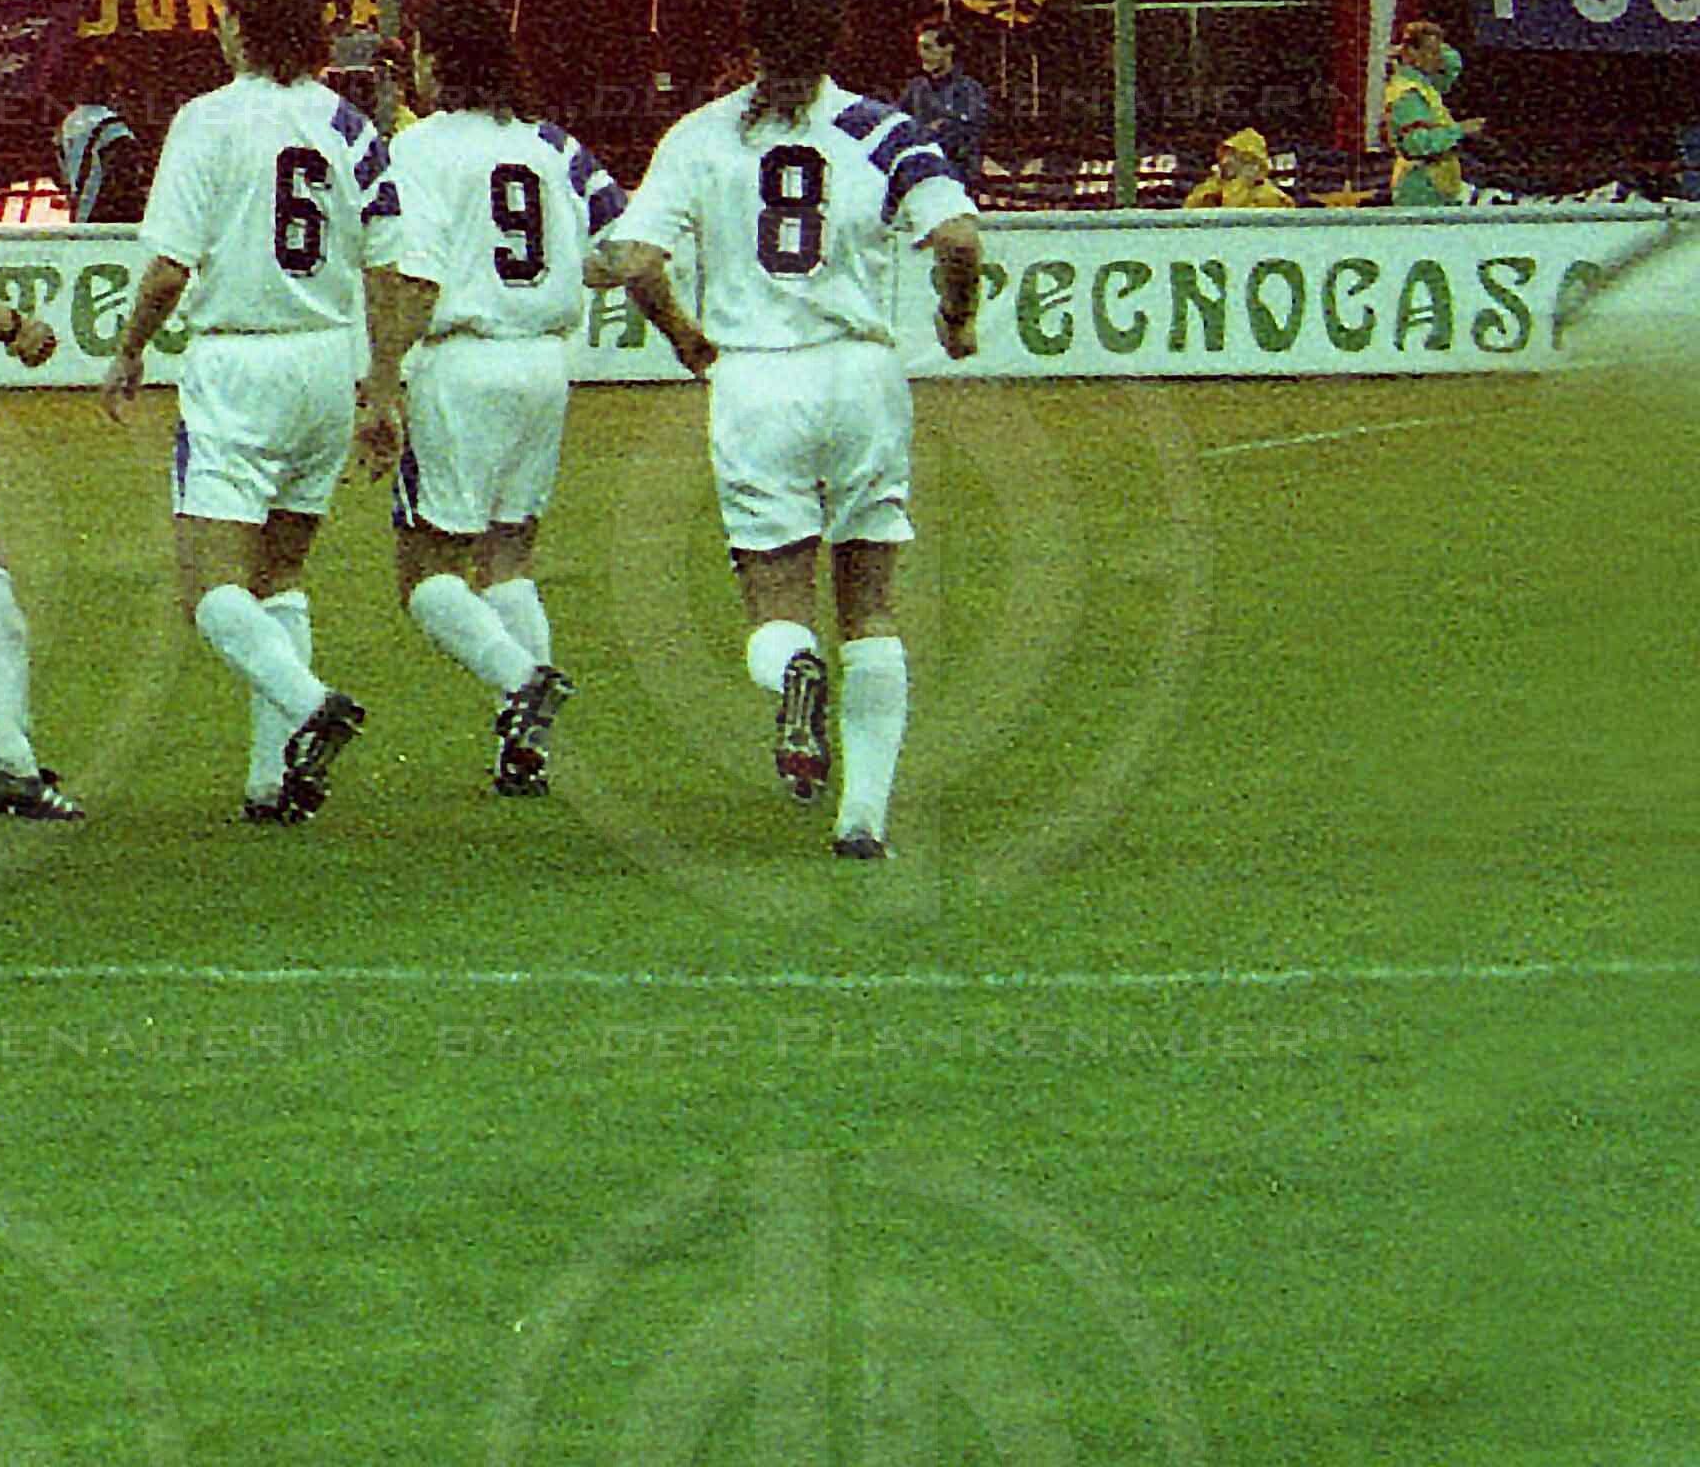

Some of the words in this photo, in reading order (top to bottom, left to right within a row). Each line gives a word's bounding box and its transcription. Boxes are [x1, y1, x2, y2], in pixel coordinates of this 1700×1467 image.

[274, 146, 332, 278] 6
[489, 162, 546, 285] 9
[756, 144, 830, 279] 8
